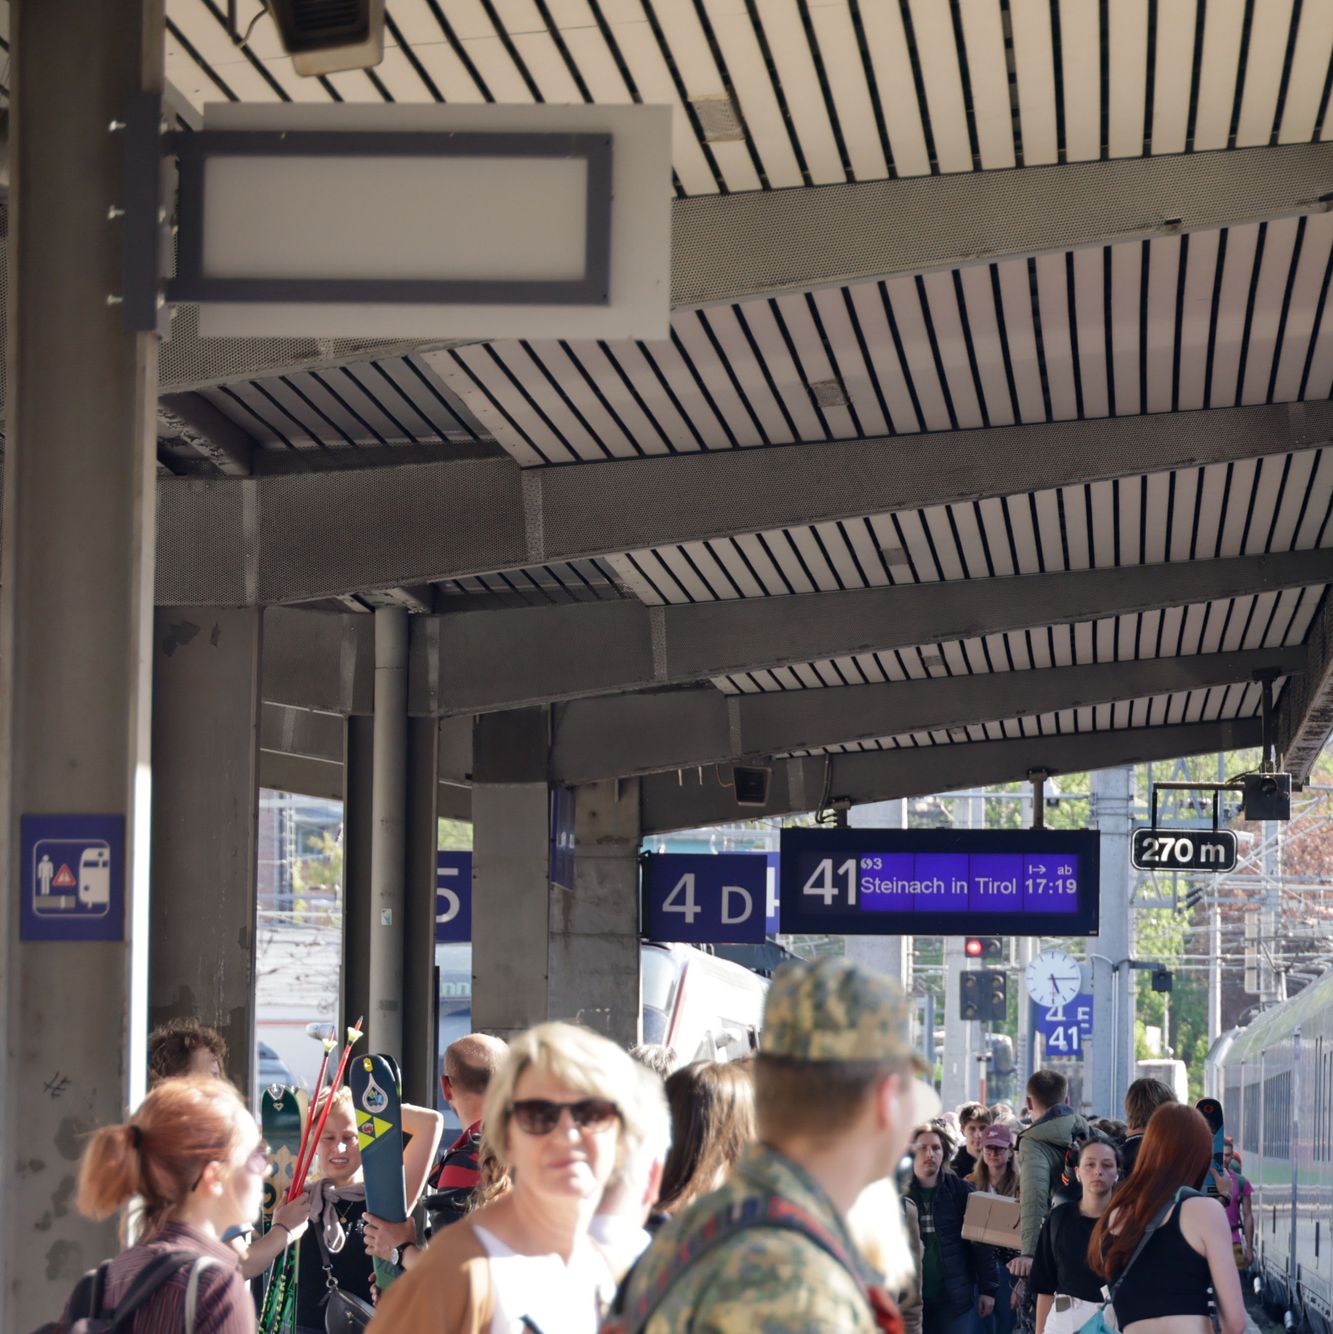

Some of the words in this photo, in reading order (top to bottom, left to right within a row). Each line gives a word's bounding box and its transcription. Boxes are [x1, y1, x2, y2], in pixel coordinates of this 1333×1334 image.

[1142, 837, 1194, 863] 270
[1200, 844, 1225, 863] m
[803, 858, 857, 905] 41
[1057, 864, 1073, 875] ab
[860, 877, 945, 894] Steinach
[952, 877, 968, 894] in
[975, 877, 1017, 894] Tirol
[1025, 878, 1077, 894] 17:19
[662, 873, 702, 924] 4
[721, 886, 753, 925] D
[1049, 1026, 1079, 1051] 41
